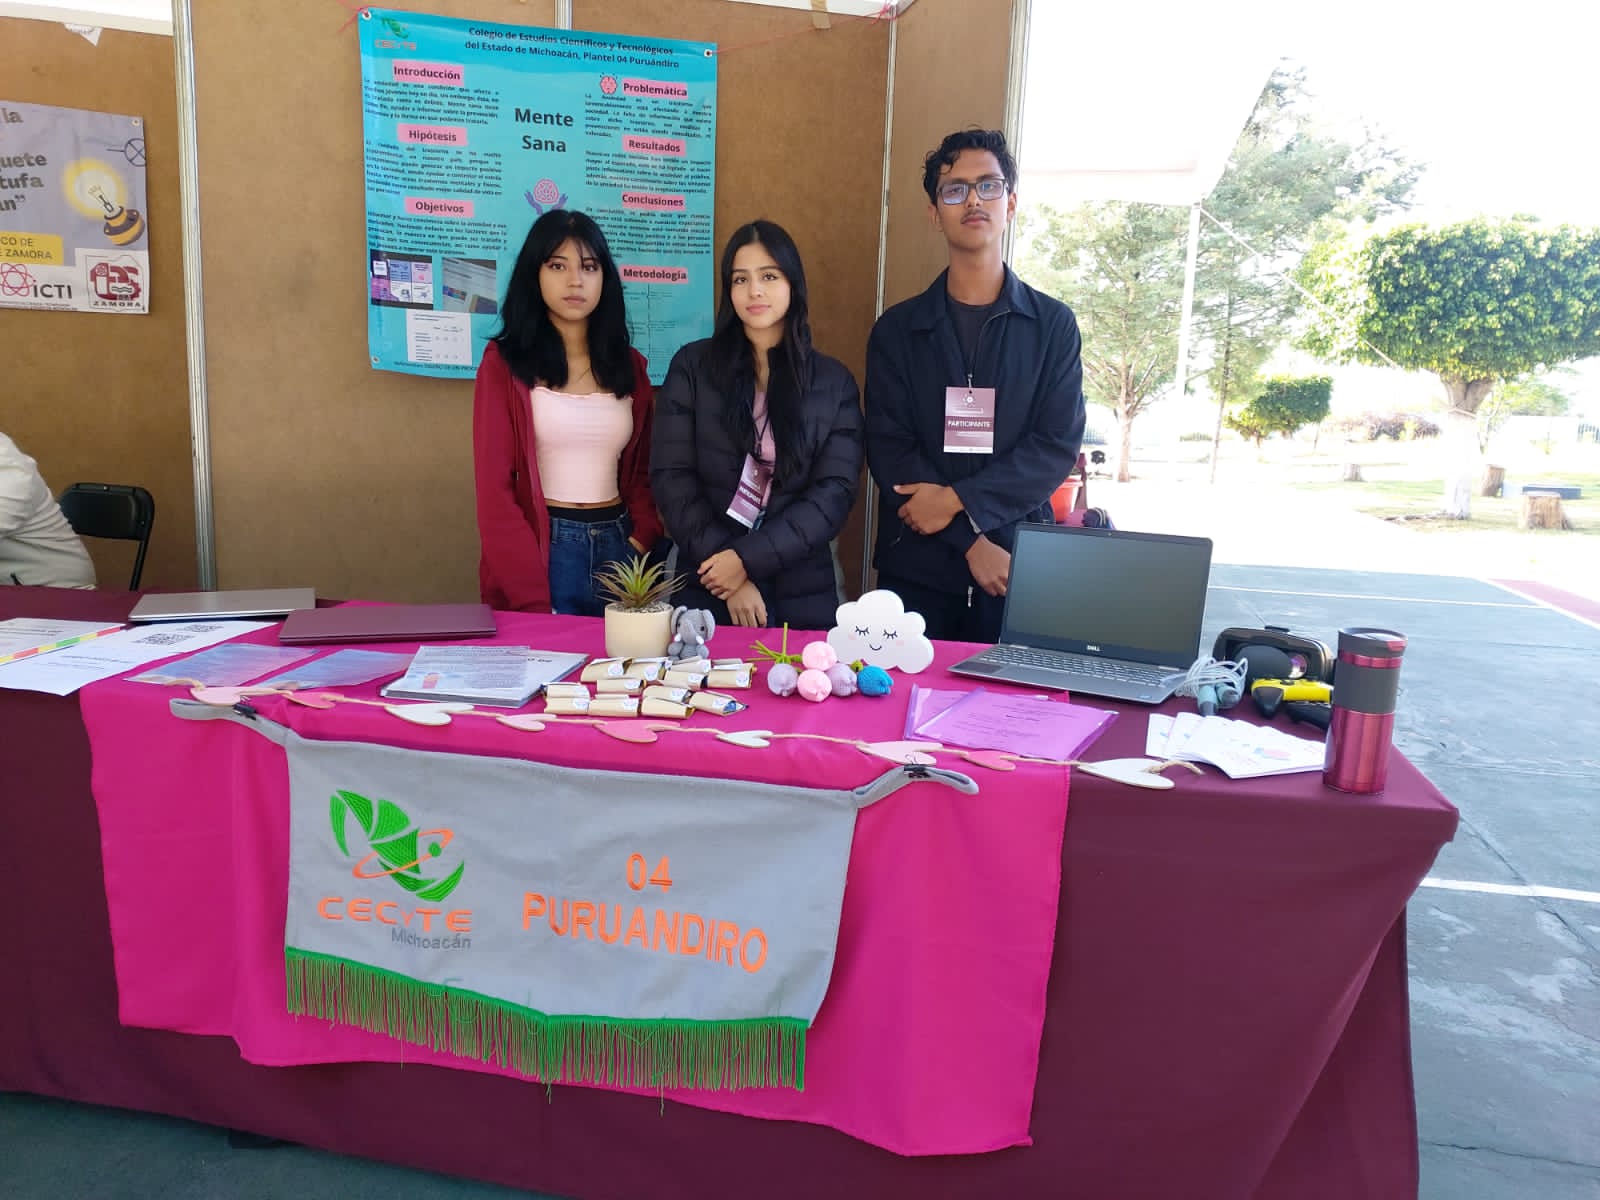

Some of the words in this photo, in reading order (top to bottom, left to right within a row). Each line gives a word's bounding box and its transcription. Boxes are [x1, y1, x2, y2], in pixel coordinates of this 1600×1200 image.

[469, 27, 503, 40] Colegio
[505, 31, 518, 39] de
[520, 32, 558, 44] Estudios
[560, 36, 607, 49] Científicos
[609, 43, 614, 51] y
[617, 41, 673, 56] Tecnológicos
[465, 40, 479, 49] del
[482, 42, 513, 53] Estado
[515, 45, 527, 54] de
[530, 46, 580, 60] Michoacán,
[584, 52, 615, 63] Plantel
[617, 55, 627, 64] 04
[629, 56, 679, 69] Puruándiro
[394, 66, 461, 80] Introducción
[623, 82, 688, 97] Problemática
[2, 107, 24, 124] la
[515, 107, 574, 127] Mente
[409, 129, 457, 142] Hipótesis
[522, 135, 567, 153] Sana
[629, 140, 681, 153] Resultados
[0, 153, 48, 170] uete
[622, 193, 684, 206] Conclusiones
[415, 201, 464, 214] Objetivos
[20, 238, 33, 247] DE
[6, 248, 53, 260] ZAMORA
[623, 268, 687, 282] Metodología
[1087, 644, 1101, 652] DELL
[626, 852, 673, 893] 04
[391, 927, 471, 950] Michoacán
[522, 891, 768, 974] PURUANDIRO
